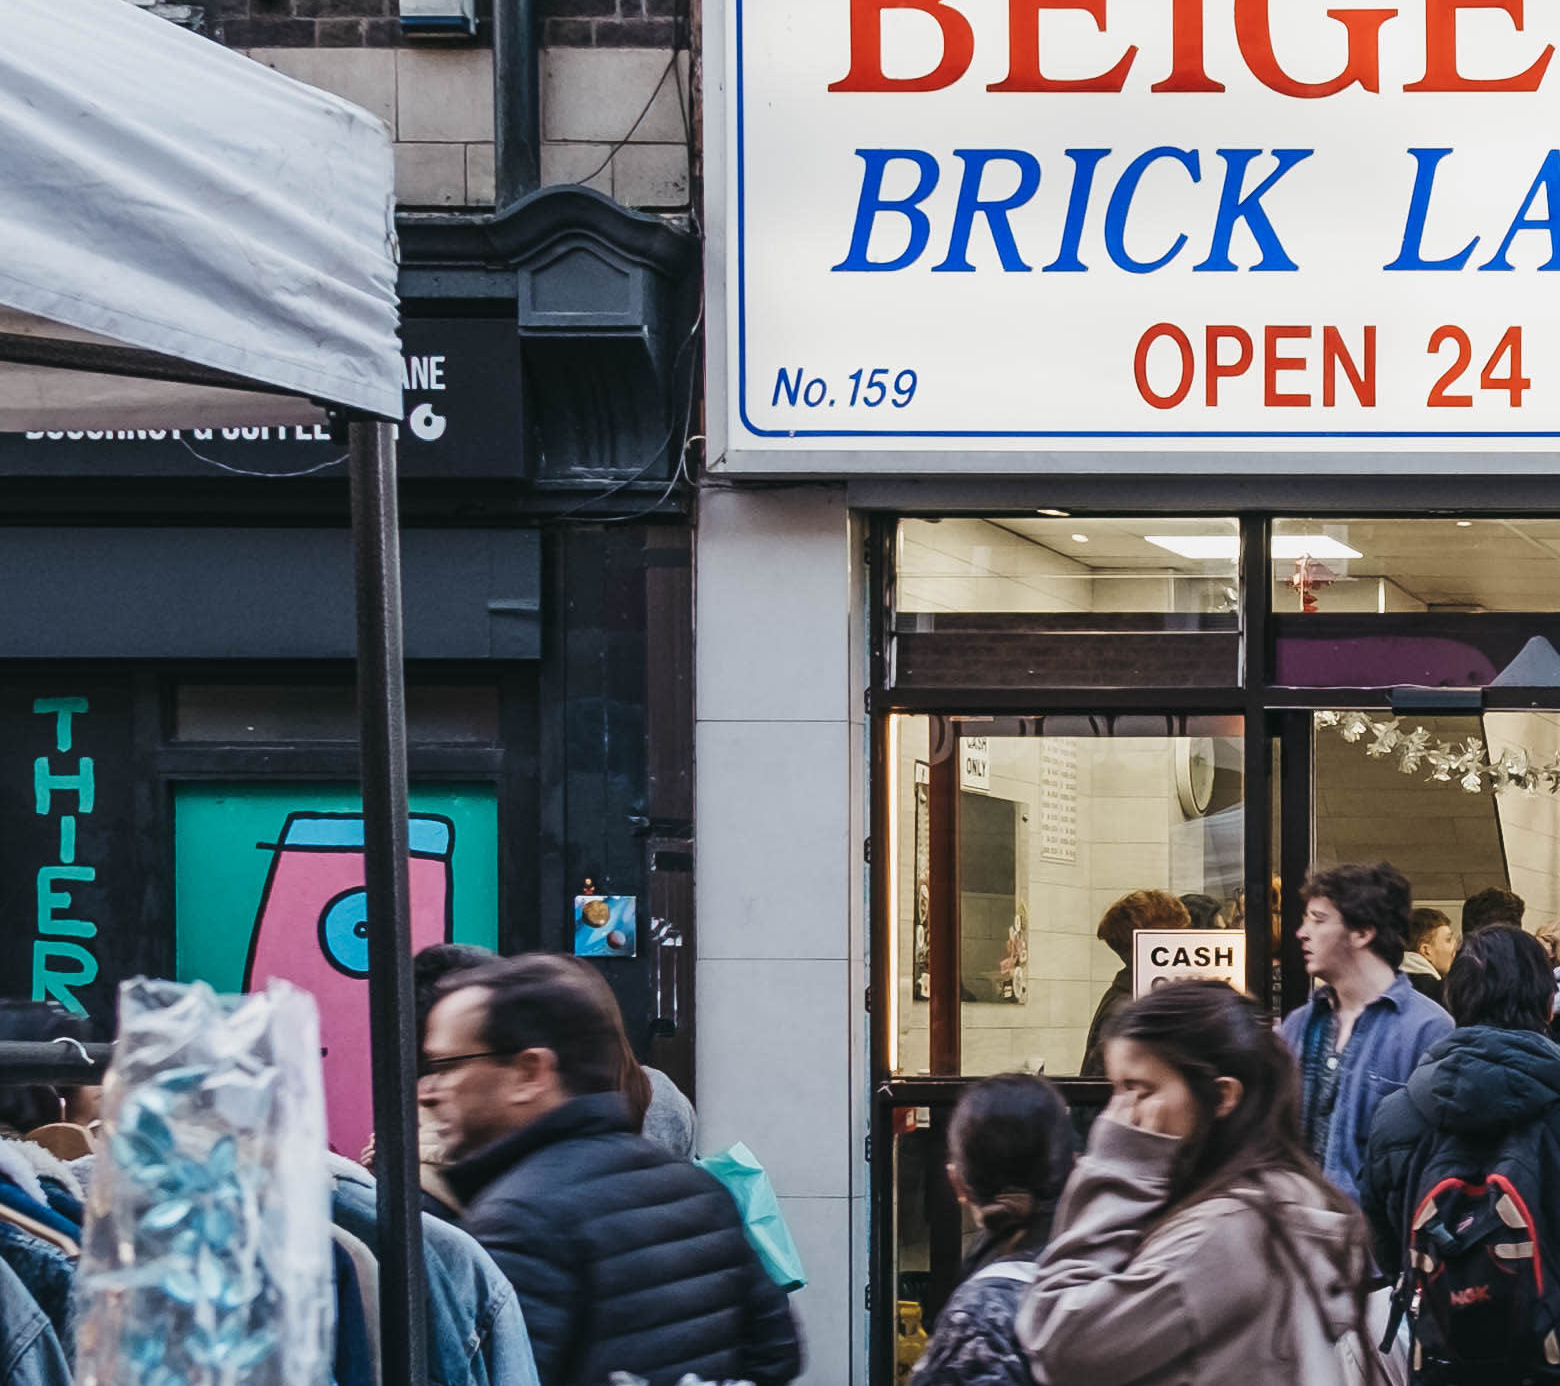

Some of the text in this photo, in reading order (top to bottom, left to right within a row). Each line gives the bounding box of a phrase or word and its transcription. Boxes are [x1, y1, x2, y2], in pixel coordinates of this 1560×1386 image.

[831, 145, 1314, 274] BRICK
[1133, 322, 1377, 410] OPEN
[1426, 324, 1532, 408] 24
[966, 757, 987, 778] ONLY
[1150, 946, 1234, 967] CASH
